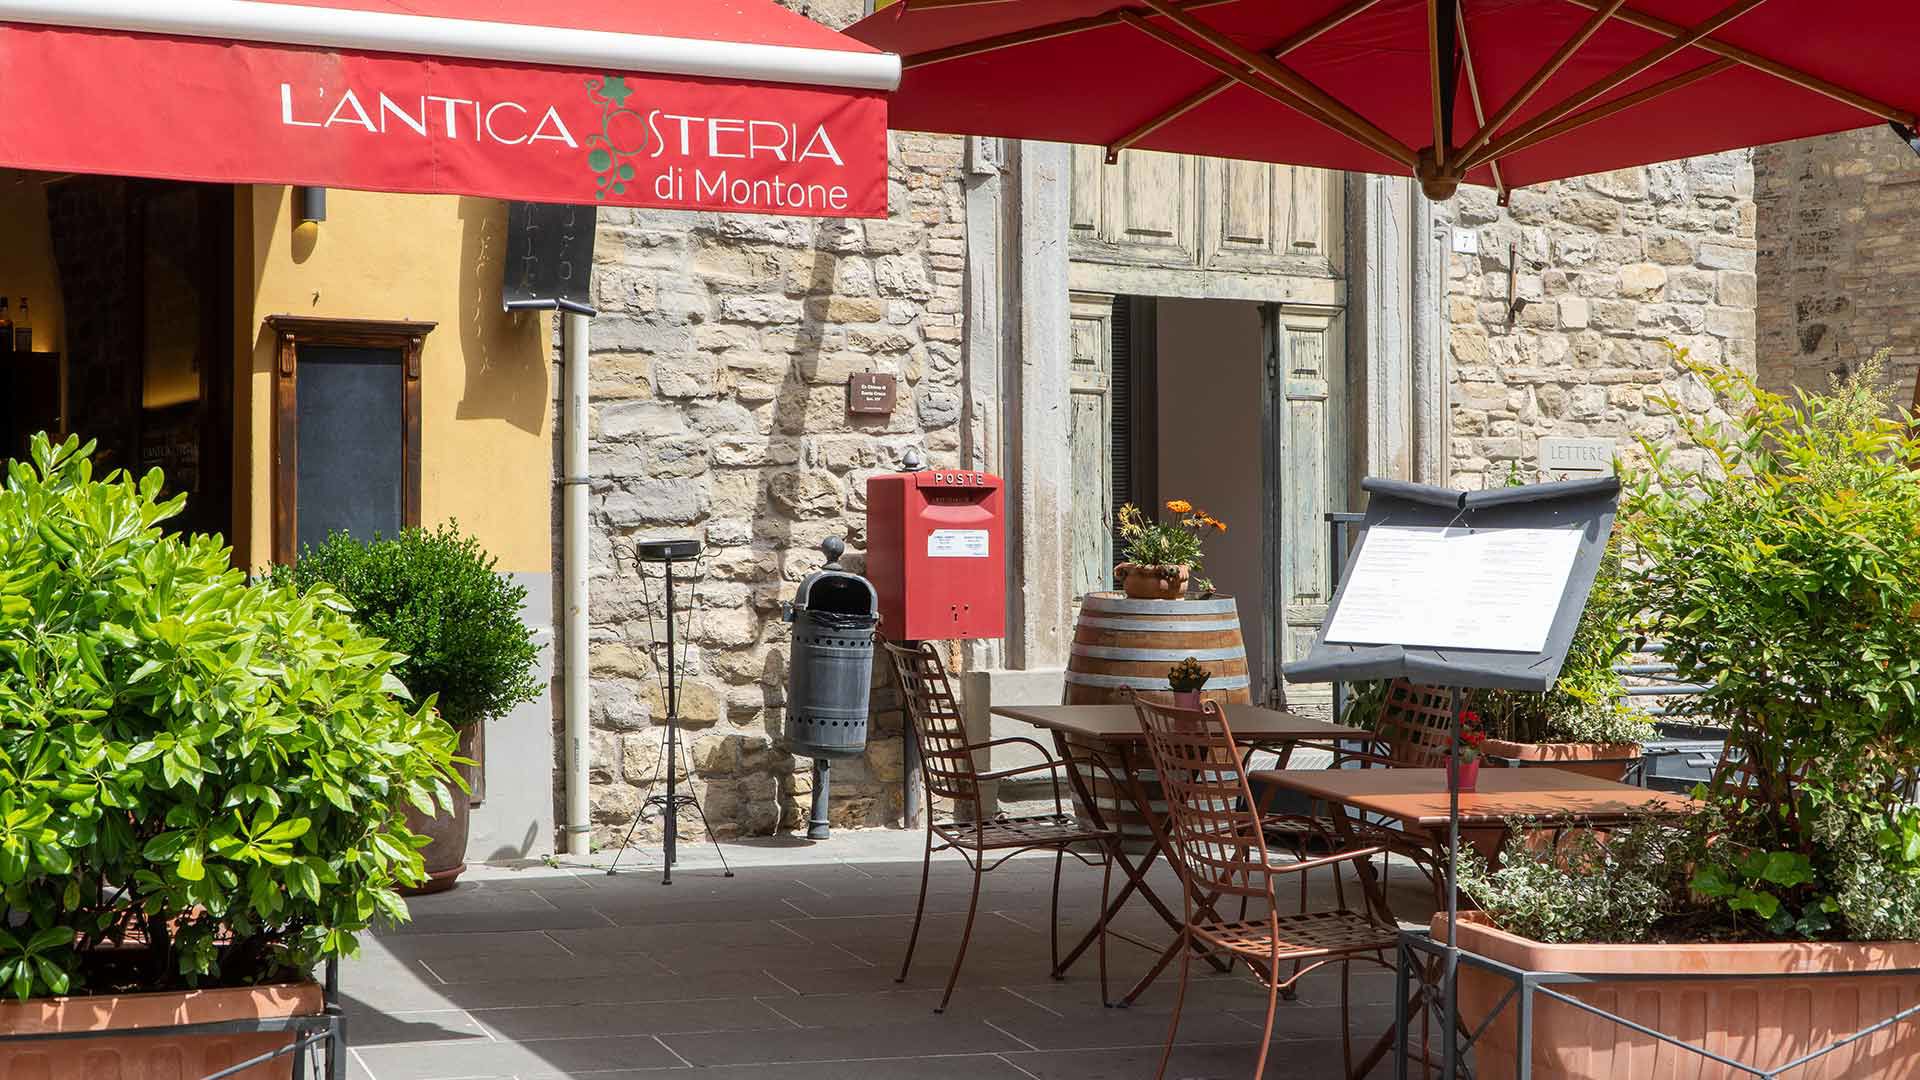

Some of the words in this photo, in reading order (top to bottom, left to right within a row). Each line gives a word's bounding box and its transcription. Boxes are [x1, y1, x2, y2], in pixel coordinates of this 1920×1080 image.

[280, 83, 579, 149] L'ANTICA
[603, 109, 845, 167] OSTERIA
[654, 165, 683, 201] di
[695, 168, 849, 210] Montone
[935, 473, 984, 485] POSTE
